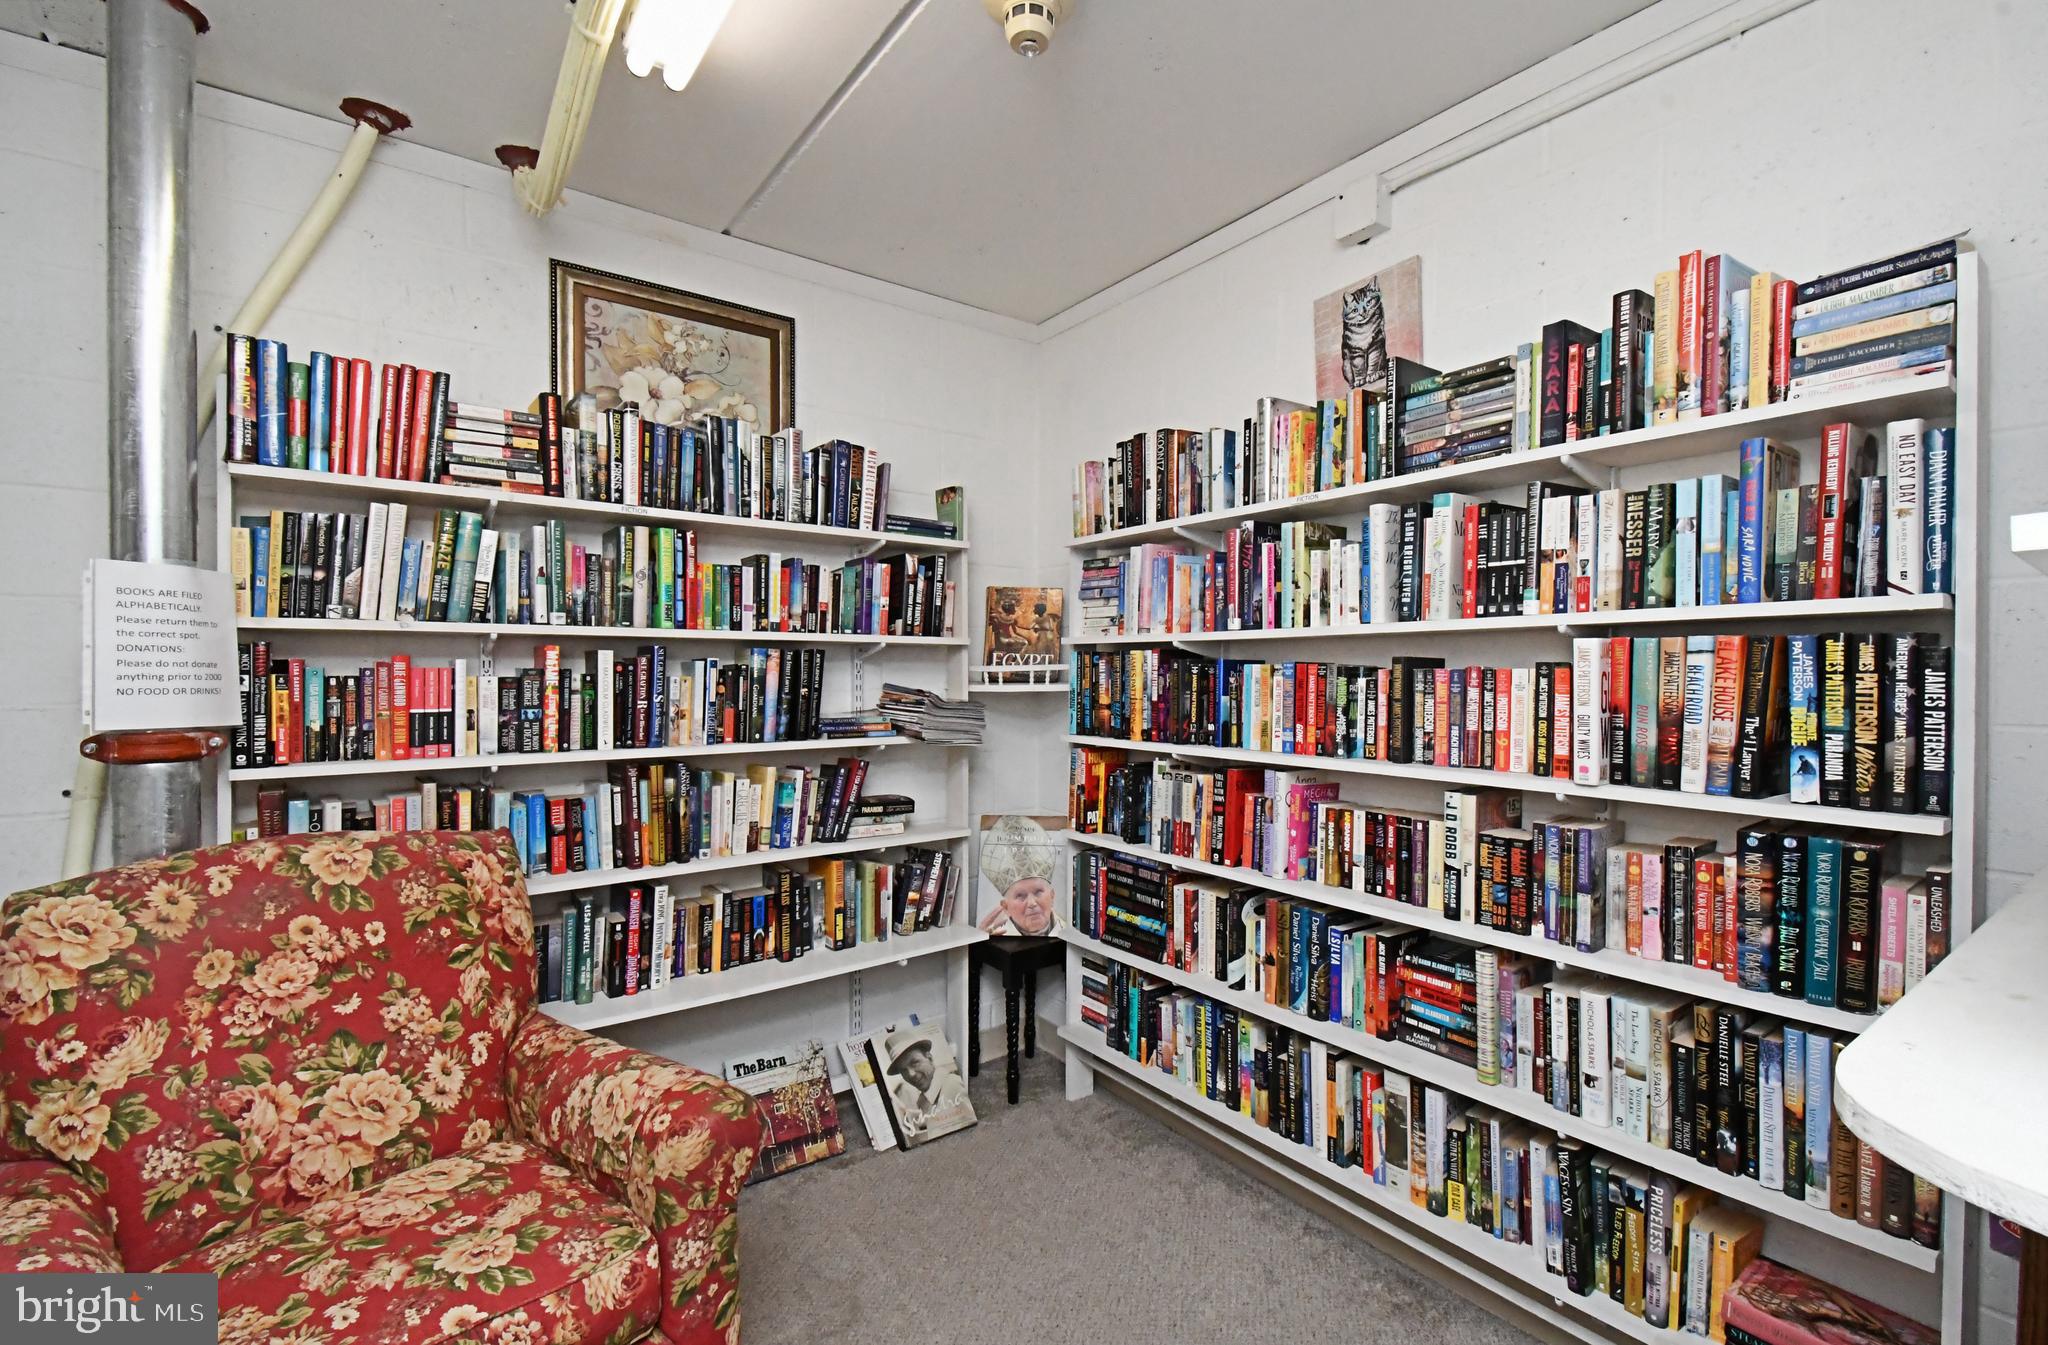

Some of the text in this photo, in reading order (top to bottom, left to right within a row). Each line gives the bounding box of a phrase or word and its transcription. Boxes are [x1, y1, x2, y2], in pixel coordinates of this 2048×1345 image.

[1862, 263, 1895, 279] MACOMBER
[1619, 294, 1630, 366] ROBERT LUDLUM'S
[1816, 343, 1896, 365] DEBBIE MACOMBER
[1545, 346, 1561, 414] SARA
[613, 412, 621, 437] ROBIN
[1157, 434, 1165, 471] KOONTZ
[1826, 429, 1841, 491] KILLING KENNEDY
[1899, 434, 1916, 504] NO EASY DAY
[611, 461, 623, 489] CRISIS
[863, 450, 877, 524] MICHAEL CRICHTON
[1928, 450, 1947, 527] DIANA PALMER
[437, 517, 453, 570] THE MAZE
[1625, 501, 1644, 558] NESSER
[1647, 506, 1663, 550] MARY
[1242, 544, 1253, 569] 1776
[1931, 533, 1942, 570] WINTER
[116, 587, 203, 600] BOOKS ARE FILED
[440, 575, 449, 603] NELSON
[472, 583, 488, 612] MAYDAY
[116, 615, 218, 629] Please return them to
[116, 629, 201, 640] the correct spot.
[116, 644, 185, 653] DONATIONS:
[116, 659, 218, 669] Please do not donate
[240, 653, 250, 671] NICCI
[993, 652, 1054, 666] EGYPT
[1663, 650, 1680, 674] JAMES
[1895, 638, 1909, 680] AMERICAN
[116, 673, 165, 682] anything
[167, 673, 191, 682] prior
[204, 673, 223, 681] 2000
[394, 661, 406, 707] JULIE GARWOOD
[1712, 647, 1738, 722] LAKE HOUSE
[1792, 641, 1803, 701] PATTERSON
[1802, 653, 1813, 689] JAMES
[1825, 639, 1844, 727] JAMES PATTERSON
[116, 687, 222, 696] NO FOOD OR DRINKS!
[523, 680, 532, 706] GEORGE
[532, 680, 540, 706] Elizabeth
[752, 684, 760, 718] GUARDIANS
[1662, 675, 1680, 715] PATTERSON
[1684, 664, 1704, 725] BEACH ROAD
[1855, 642, 1879, 745] JAMES PATTERSON
[508, 725, 516, 751] CARELESS
[531, 721, 540, 751] THIS BODY
[1295, 723, 1304, 744] GONE
[1553, 693, 1570, 756] JAMES PATTERSON
[1577, 714, 1590, 760] GUILTY WIVES
[1744, 716, 1760, 735] The
[1923, 668, 1946, 772] JAMES PATTERSON
[523, 729, 532, 751] DEATH
[1824, 733, 1844, 780] PARANOIA
[1892, 716, 1906, 793] JAMES PATTERSON
[1738, 746, 1757, 781] Lawyer
[1854, 745, 1876, 793] Writer
[551, 805, 560, 824] HILL
[926, 852, 943, 894] STEPHEN KING
[1741, 852, 1763, 911] NORA ROBERTS
[1777, 851, 1801, 907] NORA ROBERTS
[1815, 852, 1832, 907] NORA ROBERTS
[628, 897, 639, 930] JOHANSEN
[1846, 865, 1869, 936] NORA ROBERTS
[1887, 897, 1897, 923] SHEILA
[1931, 886, 1943, 933] UNLEASHED
[583, 904, 591, 954] LISA JEWELL
[1886, 925, 1897, 958] ROBERTS
[1330, 939, 1341, 965] SILVA
[626, 954, 638, 988] JOHANSEN
[1846, 957, 1866, 991] TRIBUTE
[1585, 1000, 1595, 1069] NICHOLAS SPARKS
[1718, 1016, 1729, 1087] DANIELLE STEEL
[732, 1056, 787, 1077] The Barn
[1653, 1018, 1662, 1103] NICHOLAS SPARKS
[1787, 1035, 1798, 1107] DANIELLE STEEL
[1557, 1151, 1571, 1187] WAGES
[1837, 1149, 1855, 1197] THE KISS
[1560, 1195, 1573, 1217] SIN
[1648, 1185, 1664, 1255] PRICELESS
